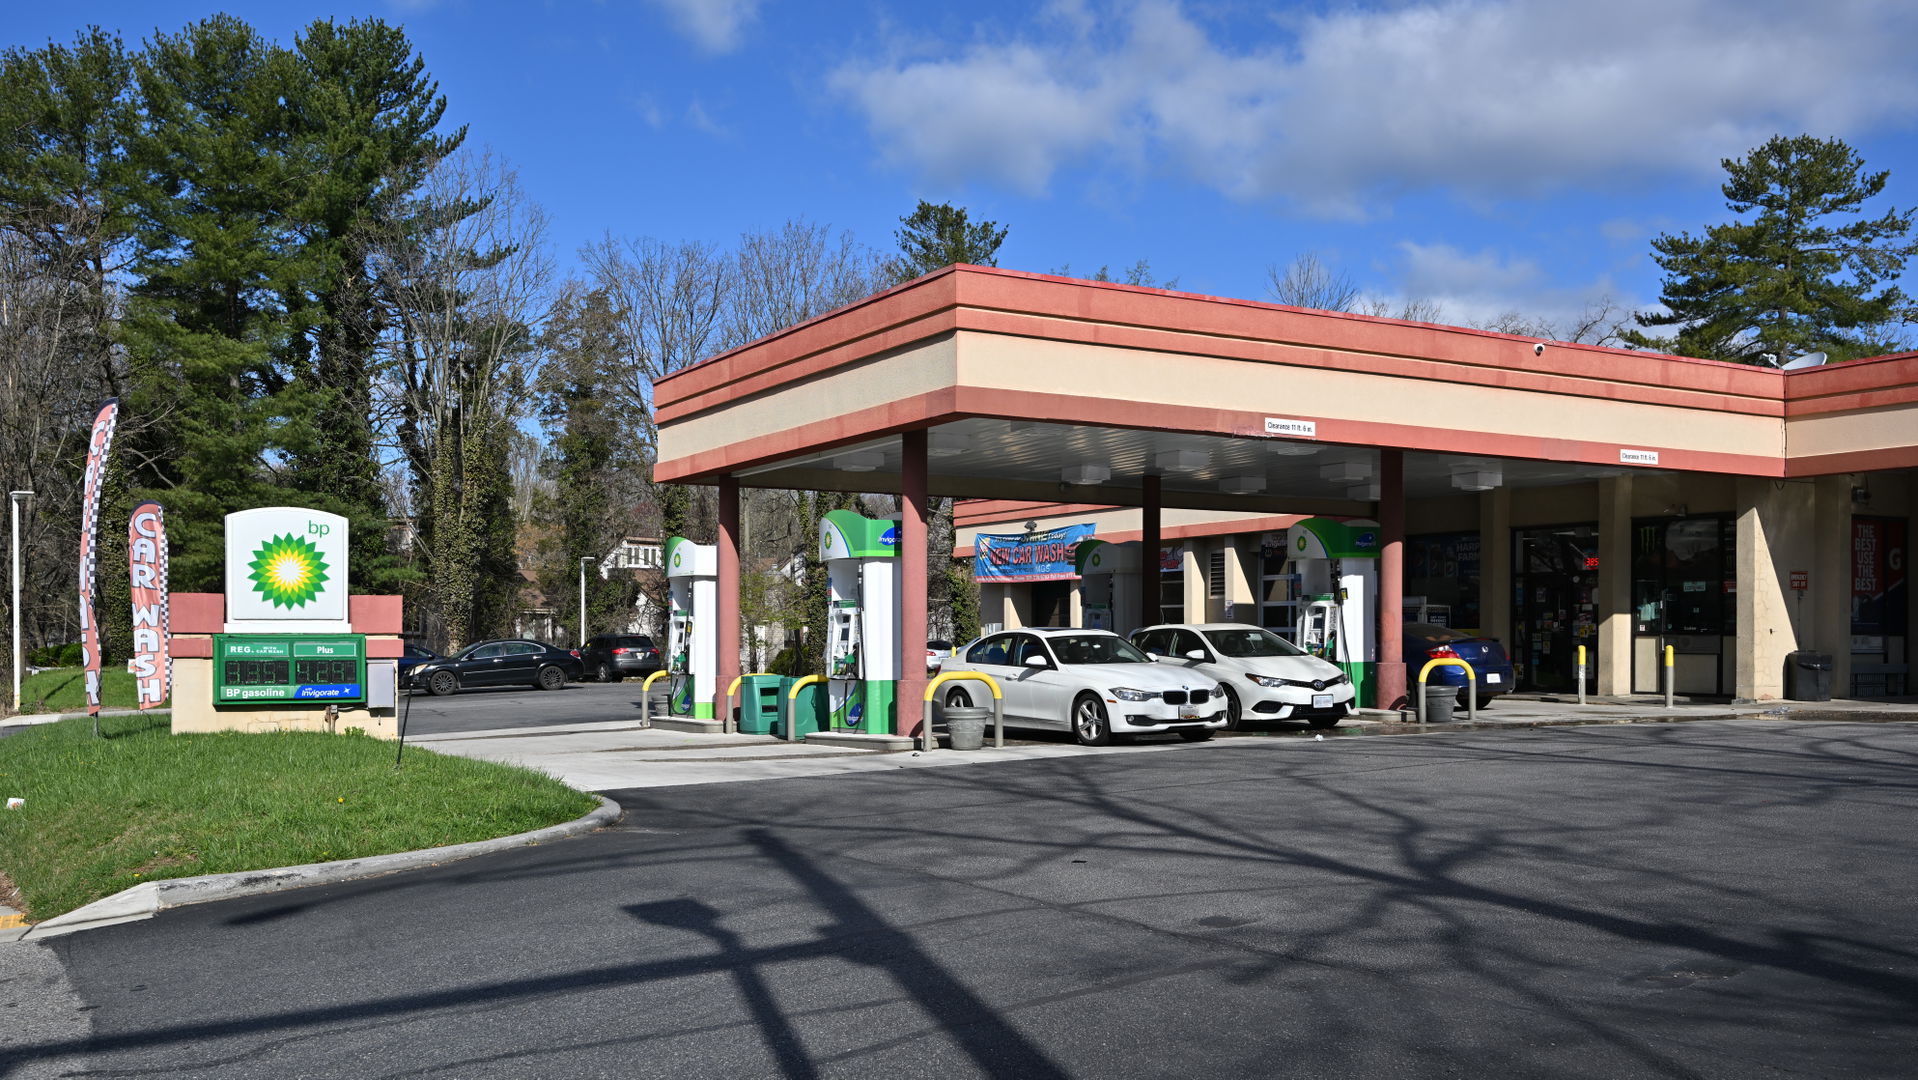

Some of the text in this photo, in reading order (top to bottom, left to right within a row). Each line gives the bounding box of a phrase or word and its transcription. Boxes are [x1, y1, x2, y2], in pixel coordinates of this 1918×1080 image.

[308, 519, 330, 539] bp
[1857, 524, 1875, 538] THE
[1855, 537, 1877, 551] BEST
[990, 543, 1064, 565] NEW CAR WASH
[1857, 551, 1875, 565] USE
[1888, 547, 1902, 571] G
[1857, 564, 1875, 578] THE
[1855, 577, 1877, 592] BEST
[131, 512, 163, 704] CAR WASH
[230, 646, 334, 654] REG. Plus
[226, 688, 285, 699] BP gasoline
